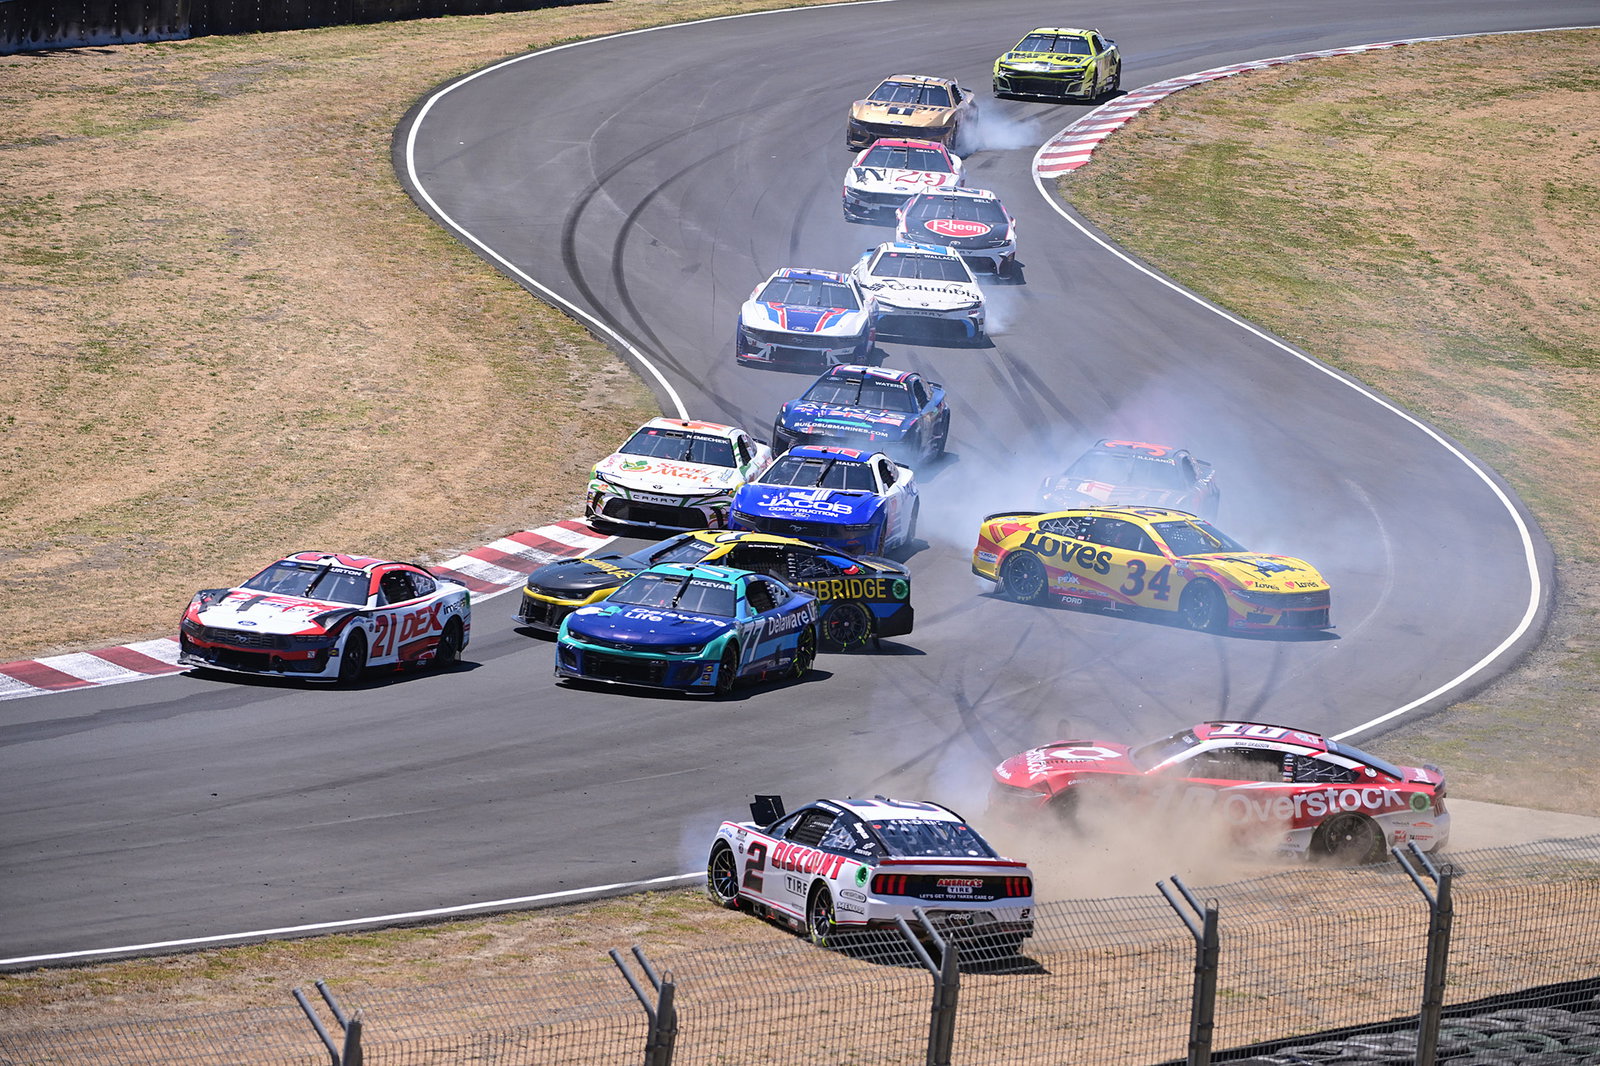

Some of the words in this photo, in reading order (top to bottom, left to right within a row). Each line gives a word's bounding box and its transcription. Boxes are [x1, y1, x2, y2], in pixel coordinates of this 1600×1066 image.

[933, 220, 986, 234] Rheem
[889, 284, 980, 301] Columbia
[875, 381, 904, 389] WATERS
[798, 402, 906, 420] AUKUS
[793, 422, 889, 438] BUILDSUBMARINES.COM
[633, 494, 678, 504] CAMRY
[757, 498, 853, 515] JACOB
[768, 506, 839, 518] CONSTRUCTION
[1119, 558, 1172, 602] 34
[1061, 595, 1083, 605] FORD
[398, 602, 443, 642] DEX
[624, 611, 664, 622] Life
[630, 607, 727, 627] Delaware
[768, 610, 809, 636] Delaware
[371, 612, 398, 659] 21
[738, 620, 766, 668] 77
[1223, 786, 1405, 826] Overstock
[742, 840, 768, 894] 2
[771, 841, 847, 880] DISCOUNT
[786, 876, 808, 896] TIRE
[937, 878, 983, 888] AMERICA'S
[1021, 908, 1031, 919] 2
